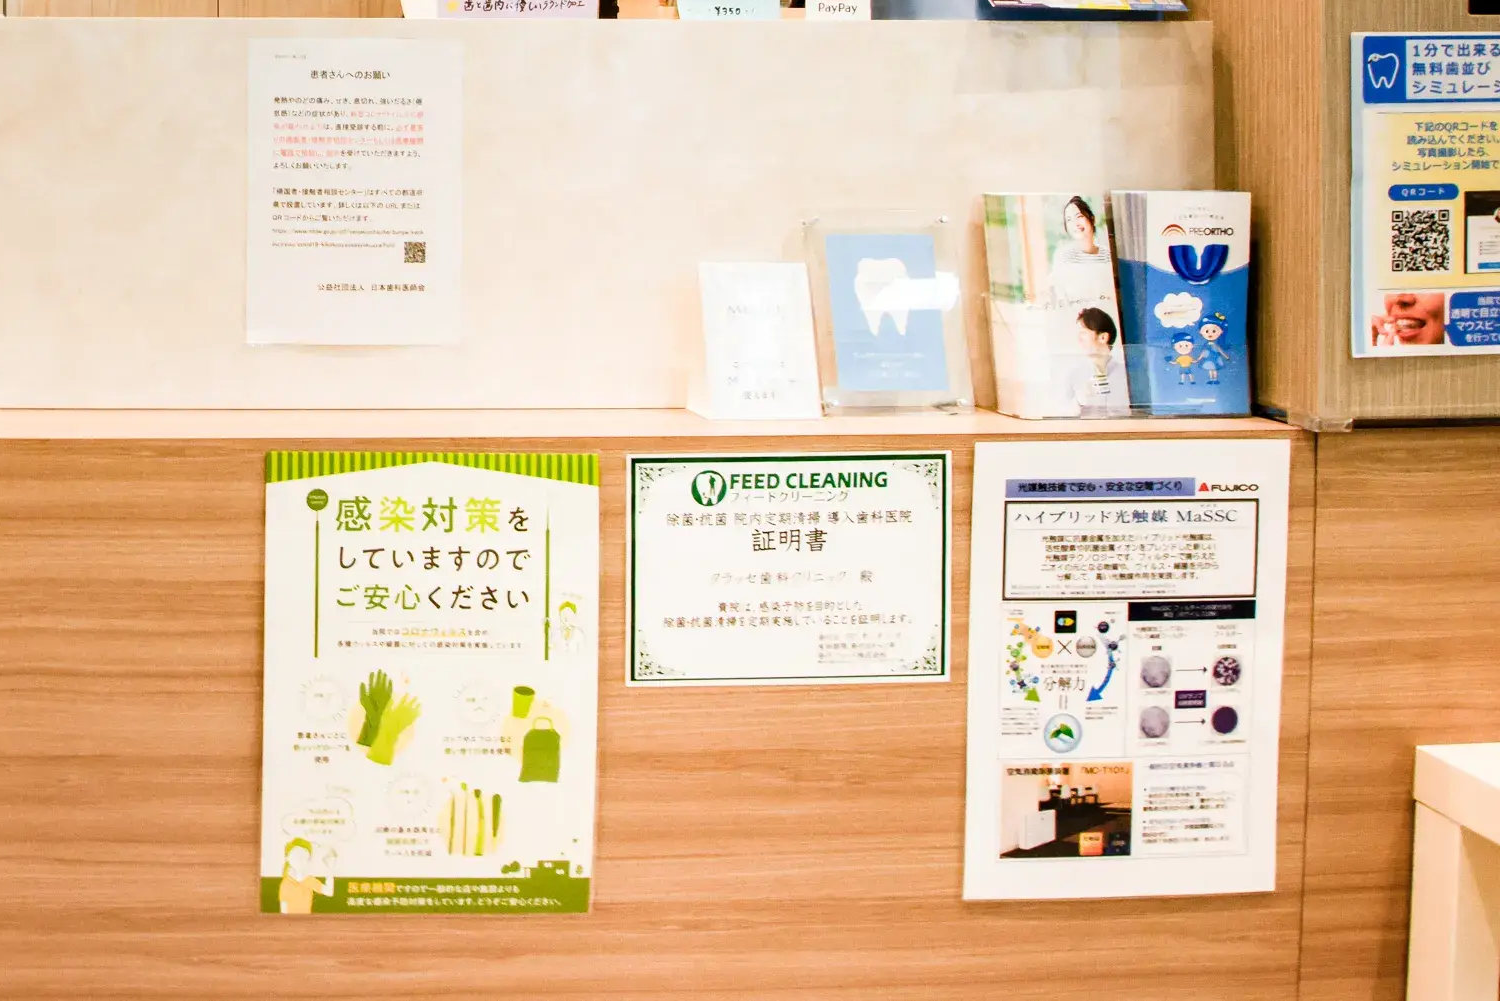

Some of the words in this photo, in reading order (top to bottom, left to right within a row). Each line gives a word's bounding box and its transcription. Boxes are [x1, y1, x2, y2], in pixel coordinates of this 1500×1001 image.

[818, 3, 858, 14] PayPay
[1413, 43, 1500, 58] 1分で出来る
[310, 70, 391, 80] 患者さんへのお願い
[1412, 62, 1491, 76] 無料歯並び
[1415, 122, 1498, 132] 下記のQRコードを
[1401, 188, 1445, 197] QRコード
[1451, 308, 1500, 319] 透明で目立
[729, 473, 781, 490] FEED
[786, 471, 888, 489] CLEANING
[1211, 484, 1259, 492] FUJICO
[335, 496, 530, 533] 感染対策を
[1014, 509, 1169, 524] ハイブリッド光触媒
[1176, 509, 1239, 524] MaSSC
[752, 528, 828, 552] 証明書
[338, 546, 531, 571] していますので
[335, 584, 530, 611] ご安心ください
[1043, 676, 1085, 691] 分解力
